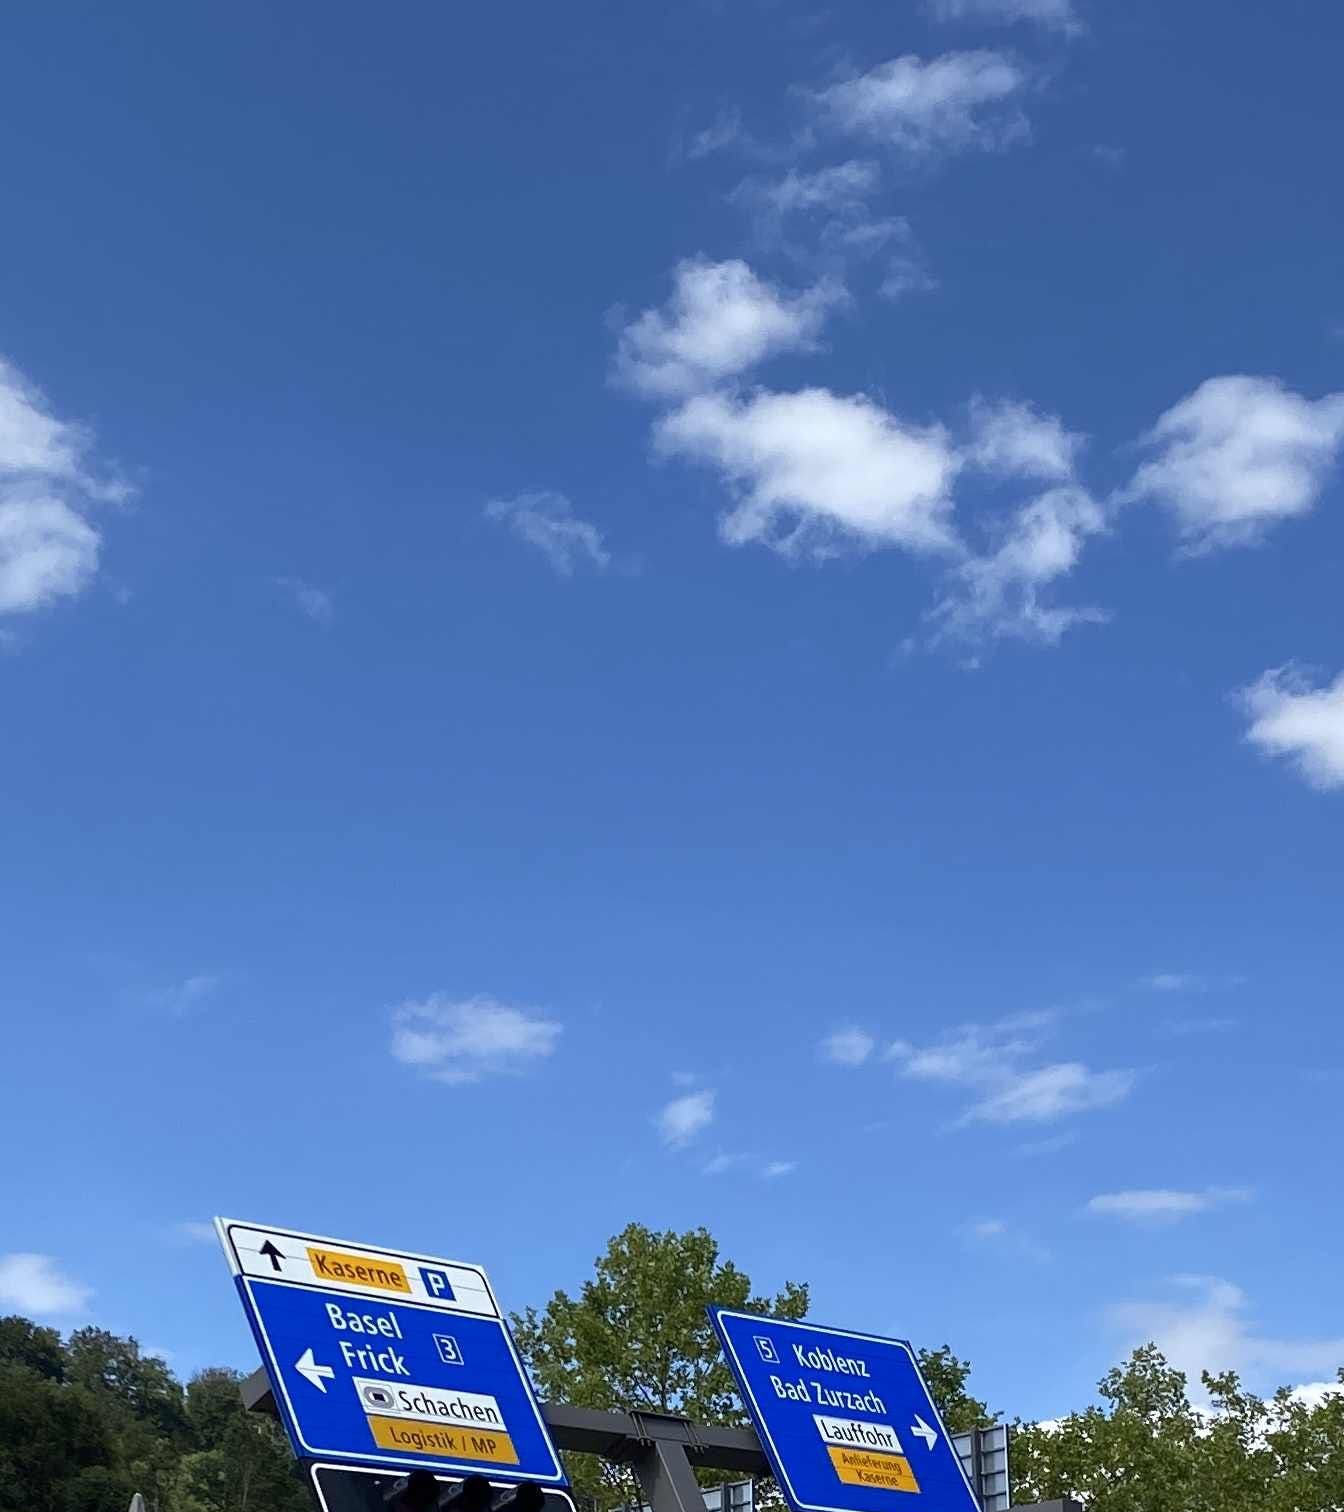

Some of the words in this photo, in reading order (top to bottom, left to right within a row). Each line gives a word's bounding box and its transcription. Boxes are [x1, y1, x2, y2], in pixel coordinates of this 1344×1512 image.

[314, 1253, 403, 1288] Kaserne
[426, 1272, 445, 1296] P
[325, 1302, 403, 1340] Basel
[338, 1340, 410, 1376] Frick
[440, 1338, 457, 1360] 3
[760, 1340, 774, 1360] 5
[792, 1343, 870, 1378] Koblenz
[398, 1390, 499, 1424] Schachen
[770, 1375, 811, 1402] Bad
[810, 1382, 887, 1415] Zurzach
[389, 1426, 457, 1450] Logistik
[471, 1437, 497, 1455] MP
[820, 1418, 895, 1448] Lauffohr
[856, 1469, 899, 1487] Kaserne
